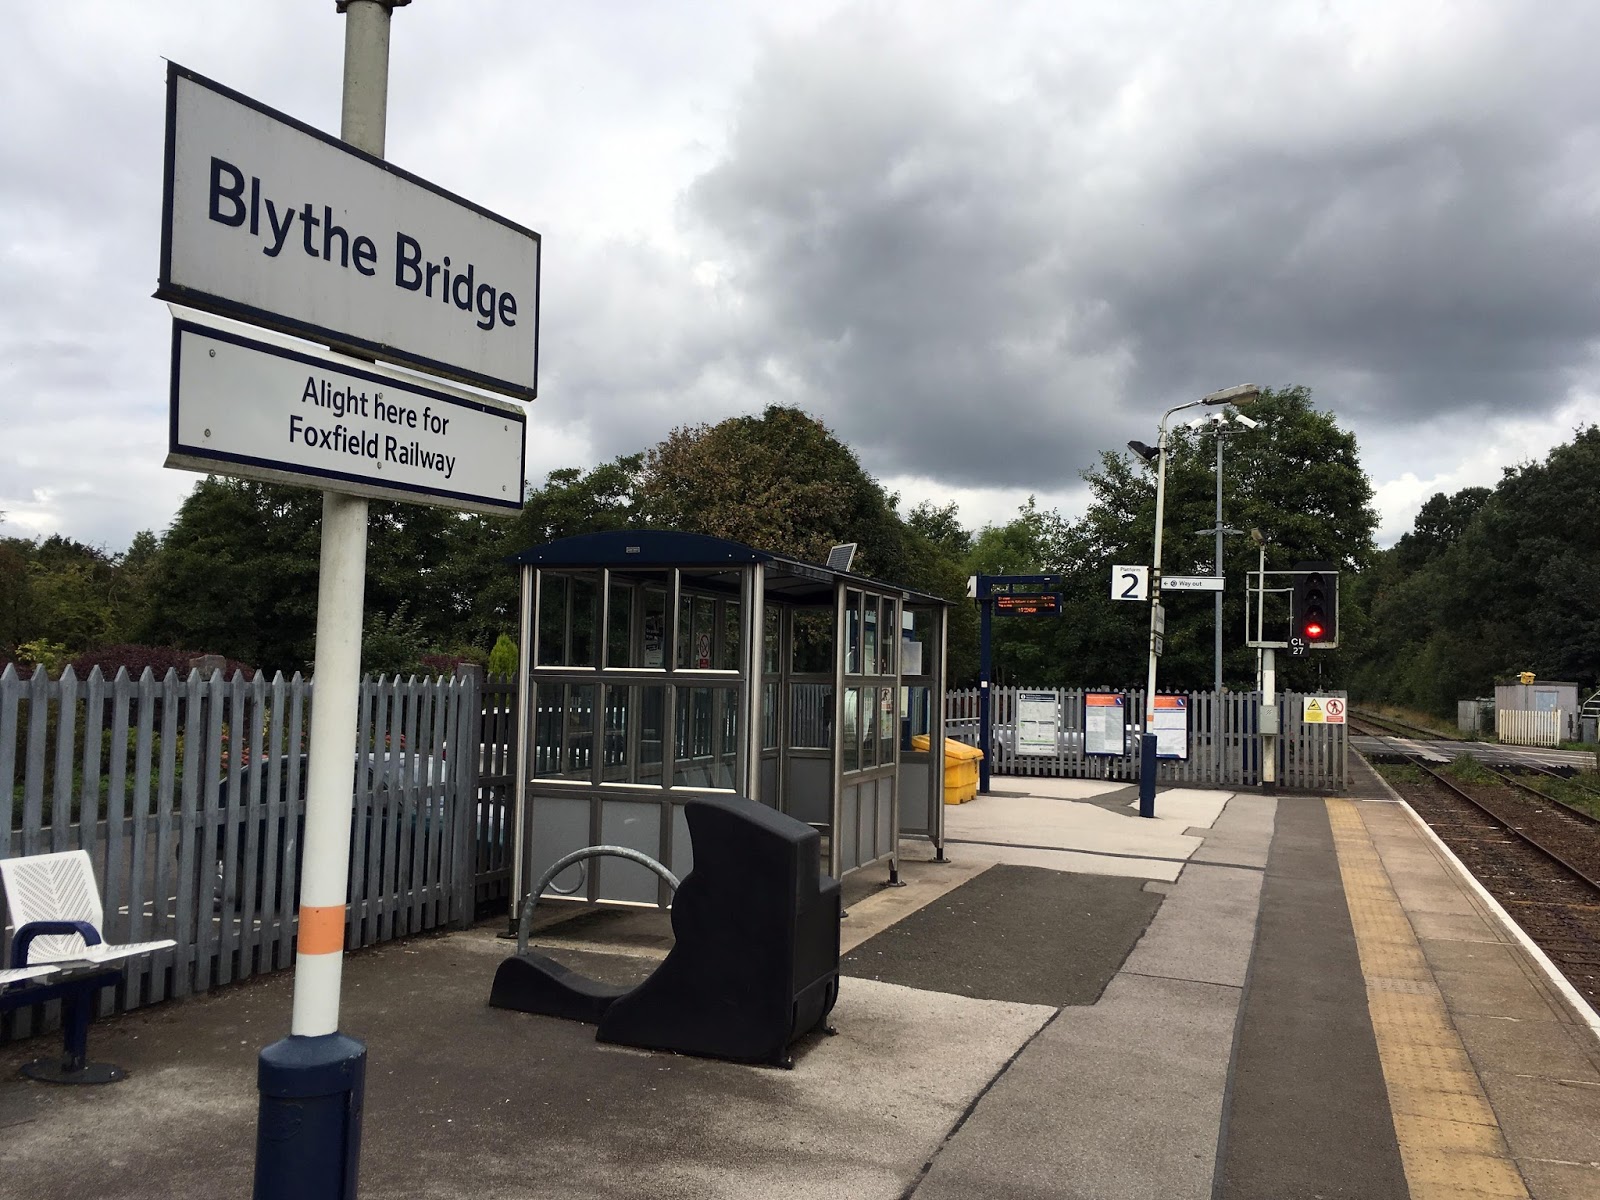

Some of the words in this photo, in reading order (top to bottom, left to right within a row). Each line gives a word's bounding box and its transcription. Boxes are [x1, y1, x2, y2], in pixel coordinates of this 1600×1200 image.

[209, 156, 378, 276] Blythe
[395, 231, 517, 331] Bridge
[302, 376, 369, 419] Alight
[374, 393, 417, 428] here
[423, 406, 450, 436] for
[289, 415, 379, 459] Foxfield
[385, 435, 456, 479] Railway
[1121, 573, 1139, 598] 2
[1291, 638, 1304, 646] CL
[1293, 647, 1304, 655] 27
